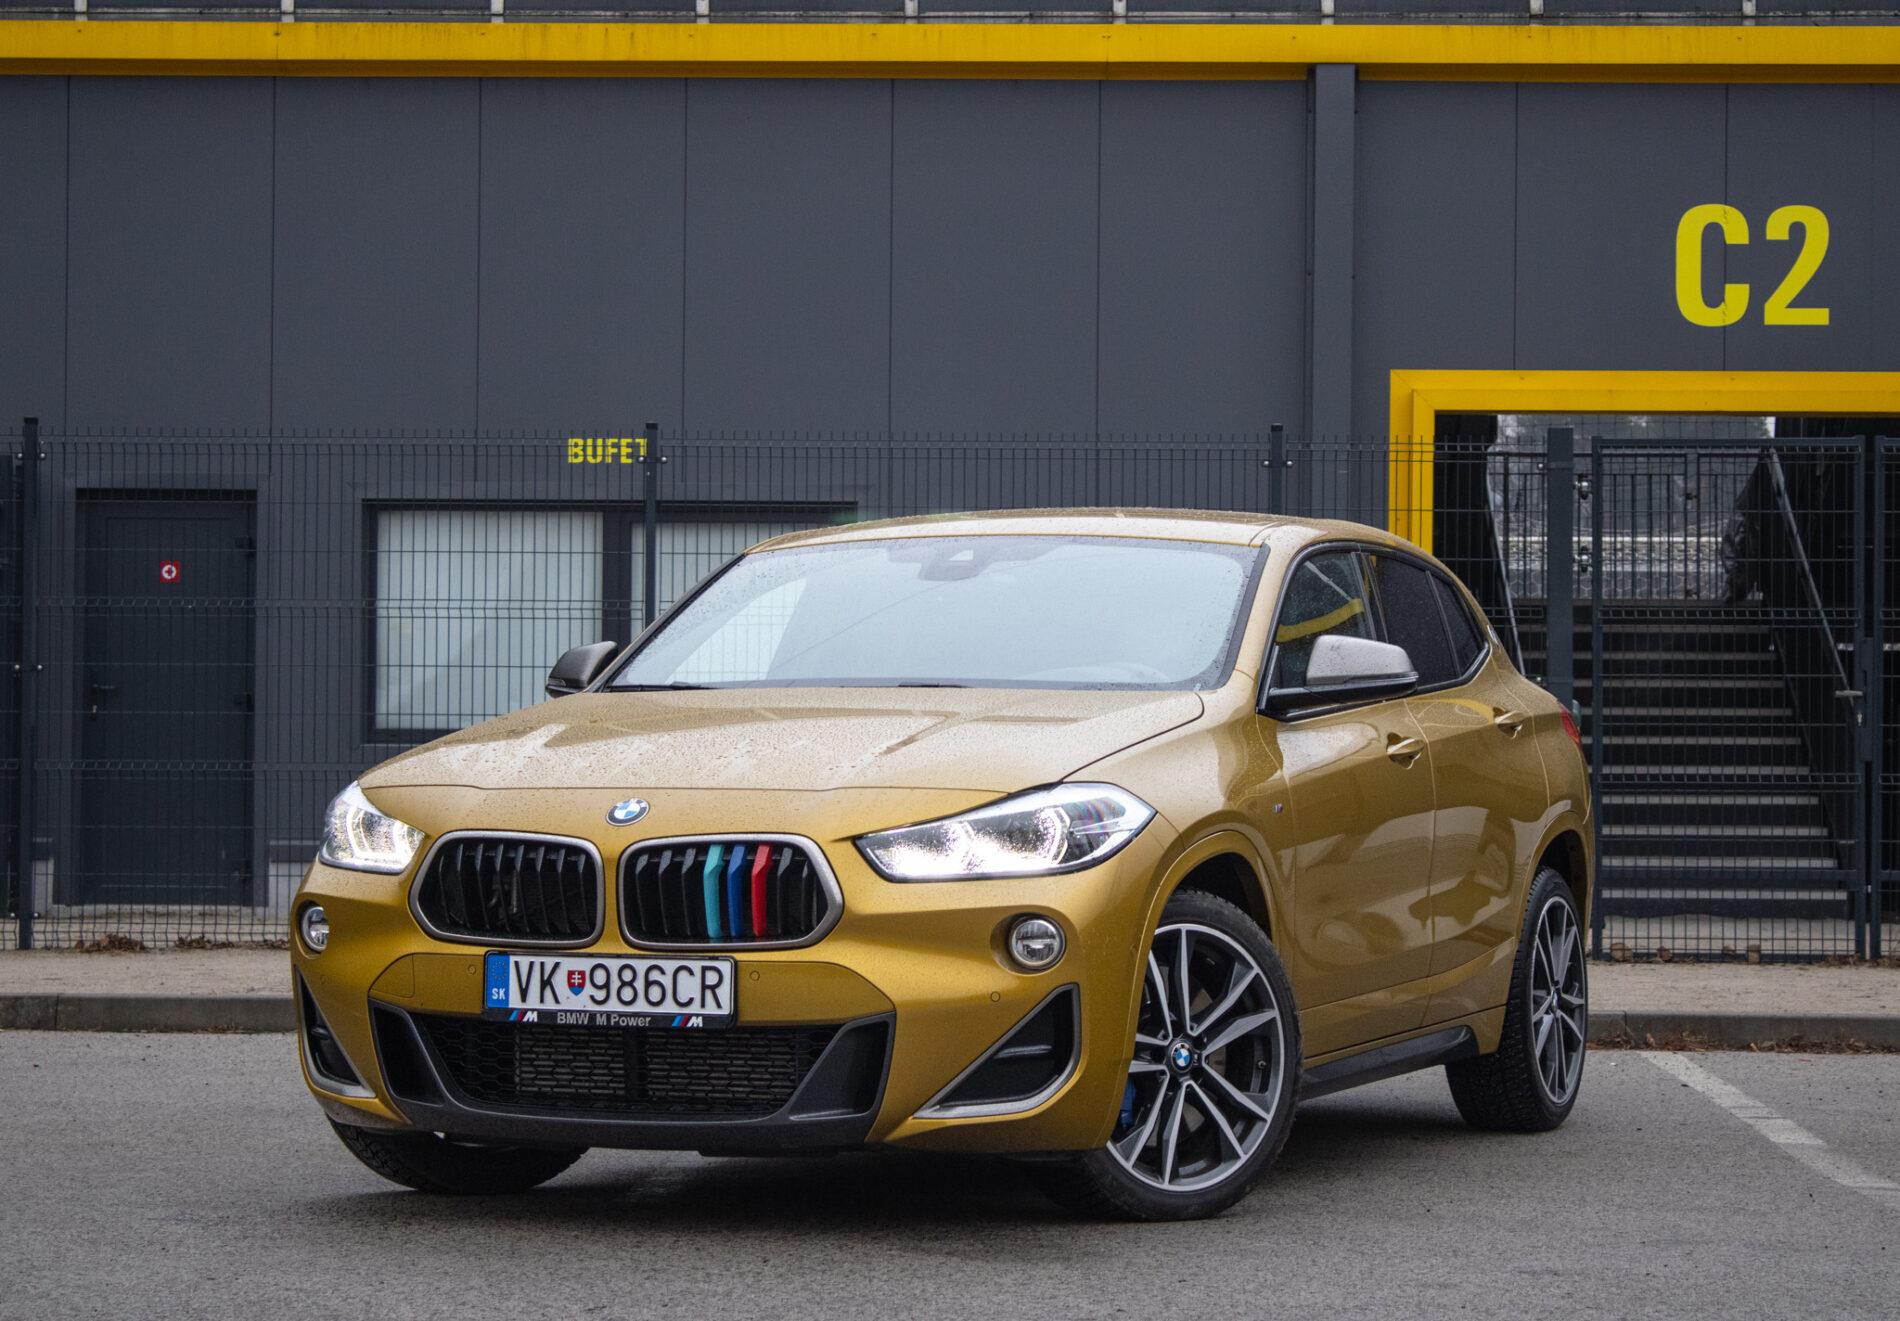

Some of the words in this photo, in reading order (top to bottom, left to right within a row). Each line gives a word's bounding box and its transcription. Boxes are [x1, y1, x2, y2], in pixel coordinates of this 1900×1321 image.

[1676, 203, 1829, 327] C2
[567, 438, 648, 464] BUFET
[491, 988, 506, 1000] SK
[513, 960, 561, 1005] VK
[588, 962, 725, 1010] 986CR
[556, 1011, 589, 1026] BMW
[595, 1013, 608, 1026] M
[609, 1014, 652, 1028] Power
